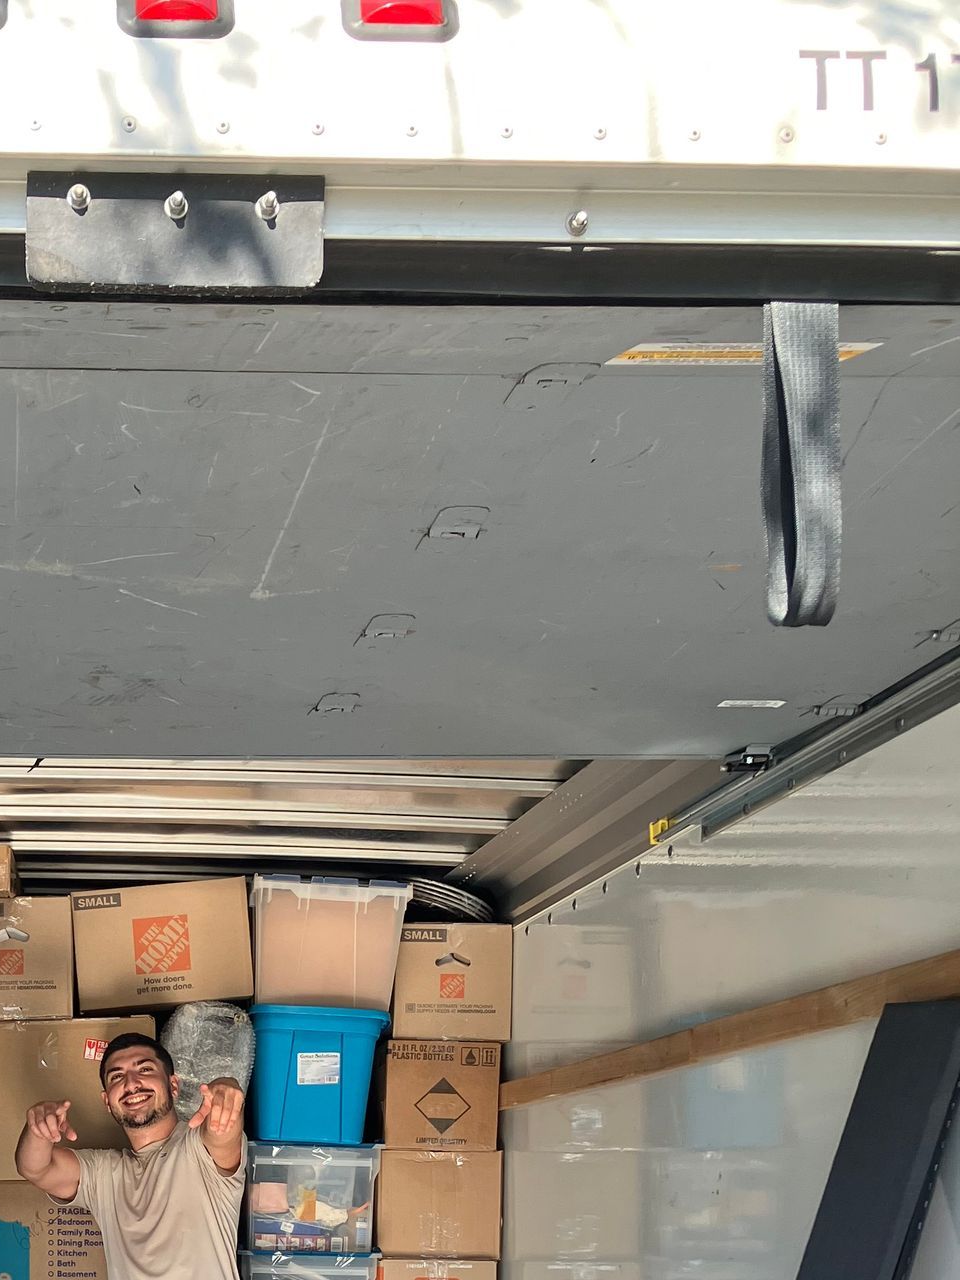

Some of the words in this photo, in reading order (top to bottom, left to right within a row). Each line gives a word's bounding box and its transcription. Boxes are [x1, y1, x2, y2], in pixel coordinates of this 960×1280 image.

[799, 50, 887, 110] TT
[914, 53, 960, 111] 1
[78, 896, 117, 908] SMALL
[139, 922, 161, 946] THE
[403, 931, 442, 940] SMALL
[135, 915, 189, 974] HOME
[158, 935, 190, 972] DEPOT
[144, 977, 161, 985] How
[163, 975, 185, 983] doers
[137, 985, 149, 995] get
[151, 984, 171, 993] more
[411, 1044, 418, 1052] FL
[420, 1045, 427, 1053] OZ
[392, 1052, 421, 1060] PLASTIC
[423, 1052, 454, 1061] BOTTLES
[57, 1229, 83, 1237] Family
[57, 1239, 83, 1248] Dining
